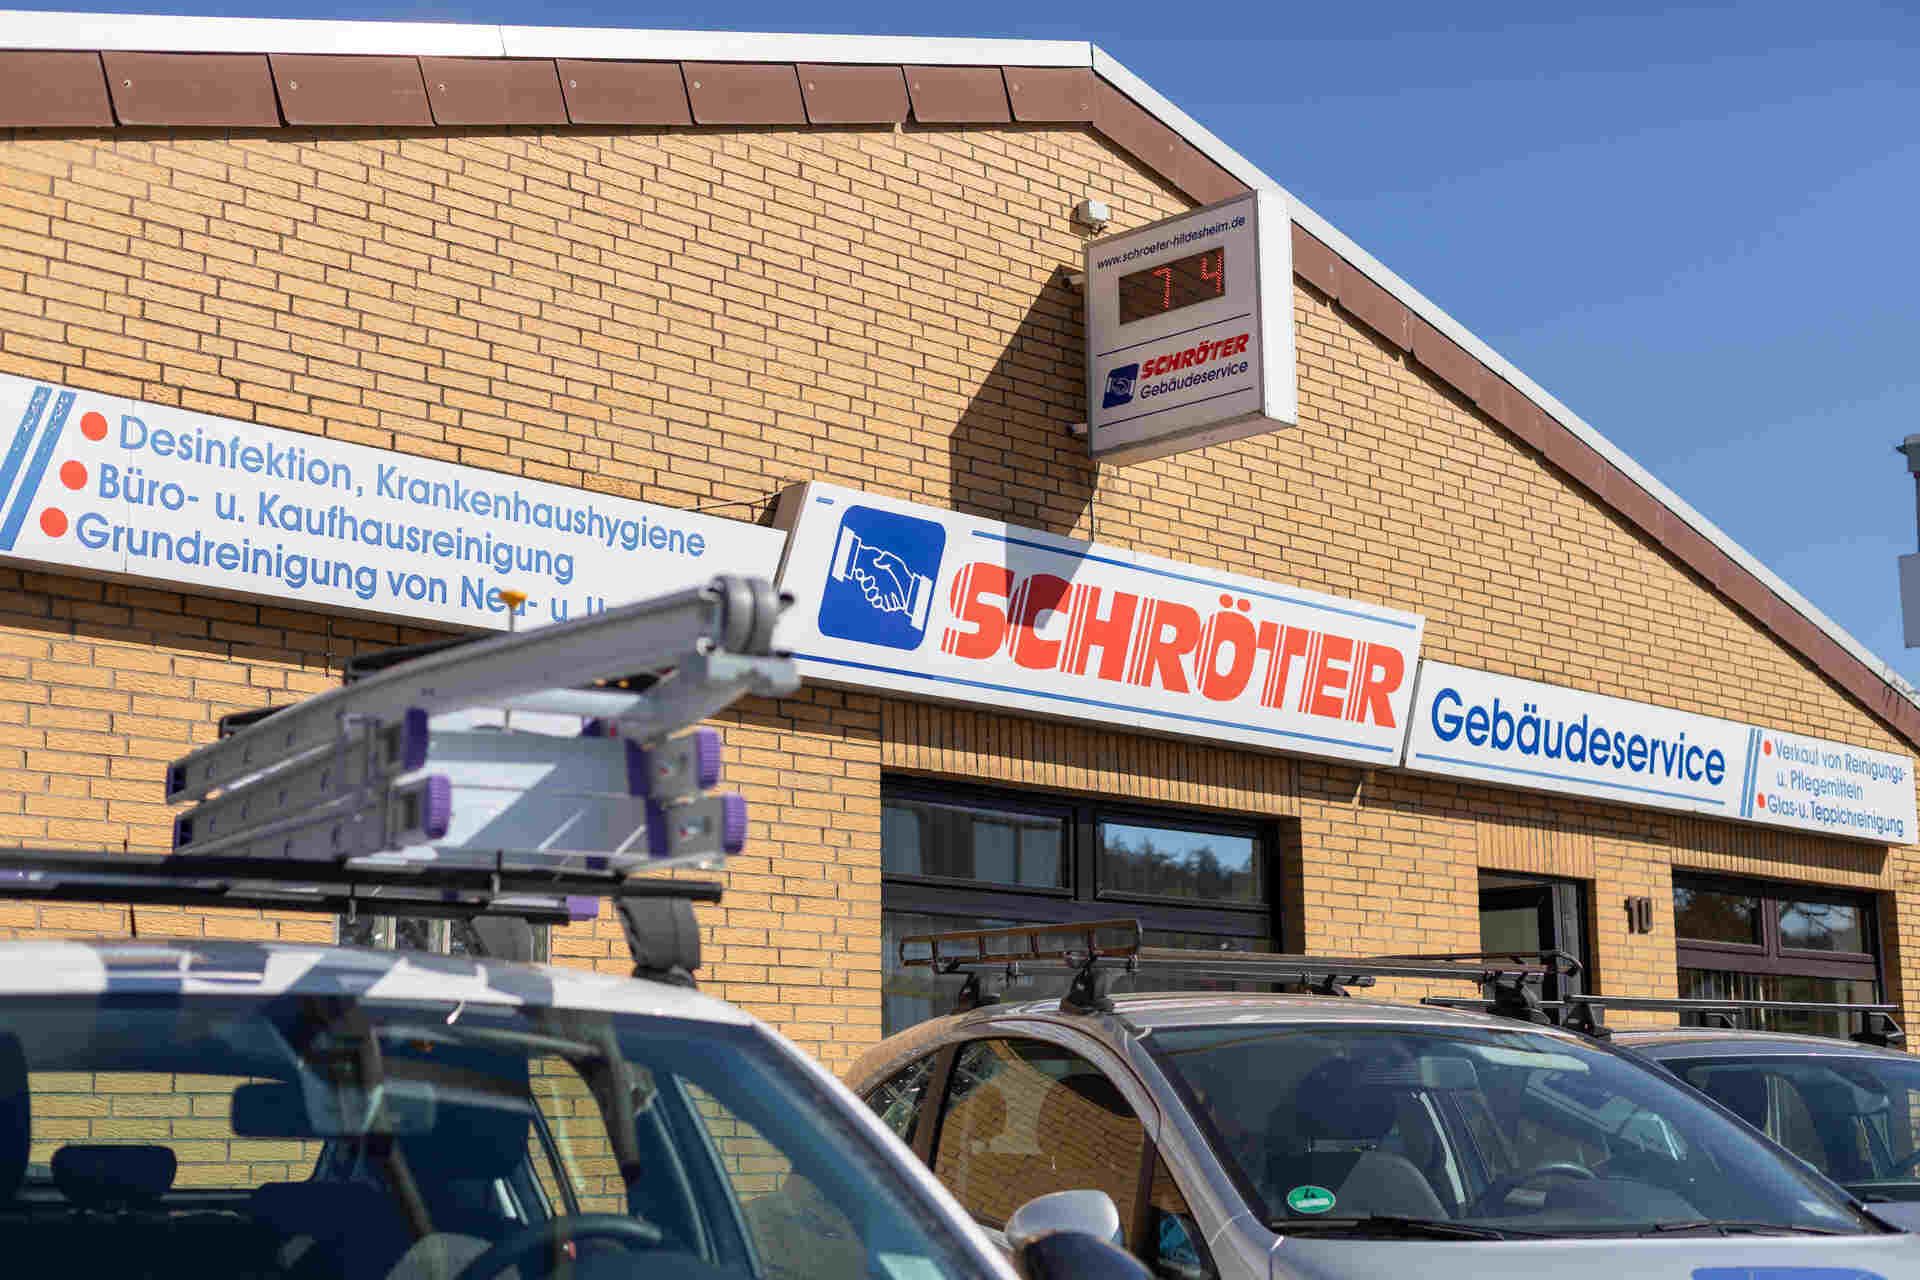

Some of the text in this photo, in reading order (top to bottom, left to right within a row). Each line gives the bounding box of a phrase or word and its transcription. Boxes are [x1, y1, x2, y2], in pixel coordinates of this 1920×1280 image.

[1097, 215, 1246, 269] www.schroeter-hildesheim.de
[1139, 361, 1249, 399] Gebäudeservice
[1140, 333, 1249, 380] SCHRÖTER
[120, 415, 706, 557] Desinfektion, Krankenhaushygiene
[100, 463, 574, 585] Büro- u. Kaufhausreinigung
[75, 512, 377, 600] Grundreinigung
[388, 570, 448, 604] von
[941, 561, 1406, 729] SCHRÖTER
[1431, 687, 1726, 786] Gebäudeservice
[1774, 738, 1907, 784] Verkauf von Reinigungs-
[1777, 769, 1864, 801] u. Pflegemitteln
[1810, 801, 1904, 838] Teppichreinigung
